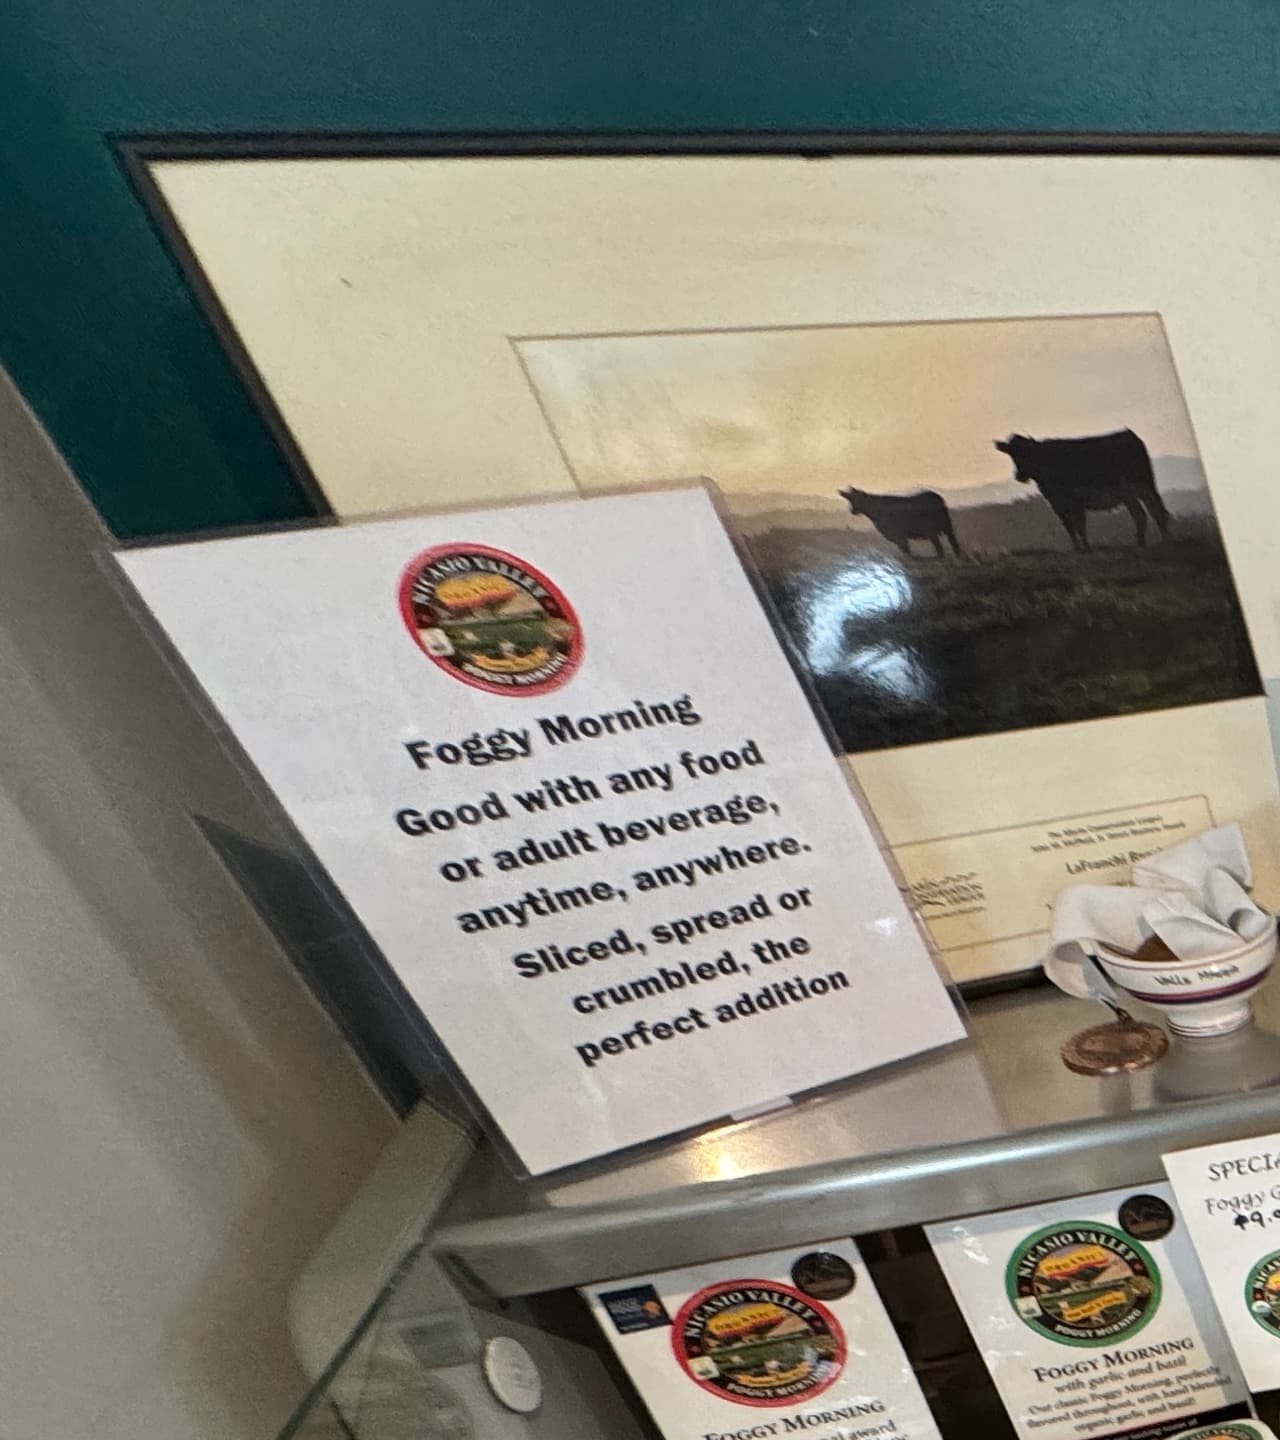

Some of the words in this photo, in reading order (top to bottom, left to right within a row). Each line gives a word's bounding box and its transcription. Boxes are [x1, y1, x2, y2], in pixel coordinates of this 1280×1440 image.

[405, 723, 531, 770] Foggy
[539, 693, 703, 750] Morning
[397, 789, 507, 839] Good
[518, 774, 600, 817] with
[611, 763, 674, 802] any
[681, 740, 765, 782] food
[440, 853, 483, 885] or
[495, 830, 595, 873] adult
[603, 791, 781, 860] beverage,
[457, 879, 628, 938] anytime,
[635, 839, 812, 902] anywhere.
[514, 929, 647, 981] Sliced,
[653, 901, 770, 953] spread
[778, 884, 813, 915] or
[572, 955, 753, 1016] crumbled,
[754, 932, 811, 970] the
[575, 1006, 710, 1068] perfect
[714, 967, 850, 1026] addition
[1205, 1191, 1267, 1216] Foggy
[1018, 1233, 1073, 1279] NICASIO
[1076, 1230, 1139, 1262] VALLEY
[685, 1294, 744, 1339] NICASIO
[747, 1290, 814, 1321] VALLEY
[1033, 1354, 1100, 1383] FOGGY
[1104, 1337, 1195, 1367] MORNING
[1054, 1375, 1085, 1393] with
[1088, 1367, 1128, 1390] garlic
[1131, 1363, 1153, 1379] and
[1156, 1355, 1187, 1374] basil
[784, 1400, 886, 1434] MORNING
[848, 1420, 897, 1440] award
